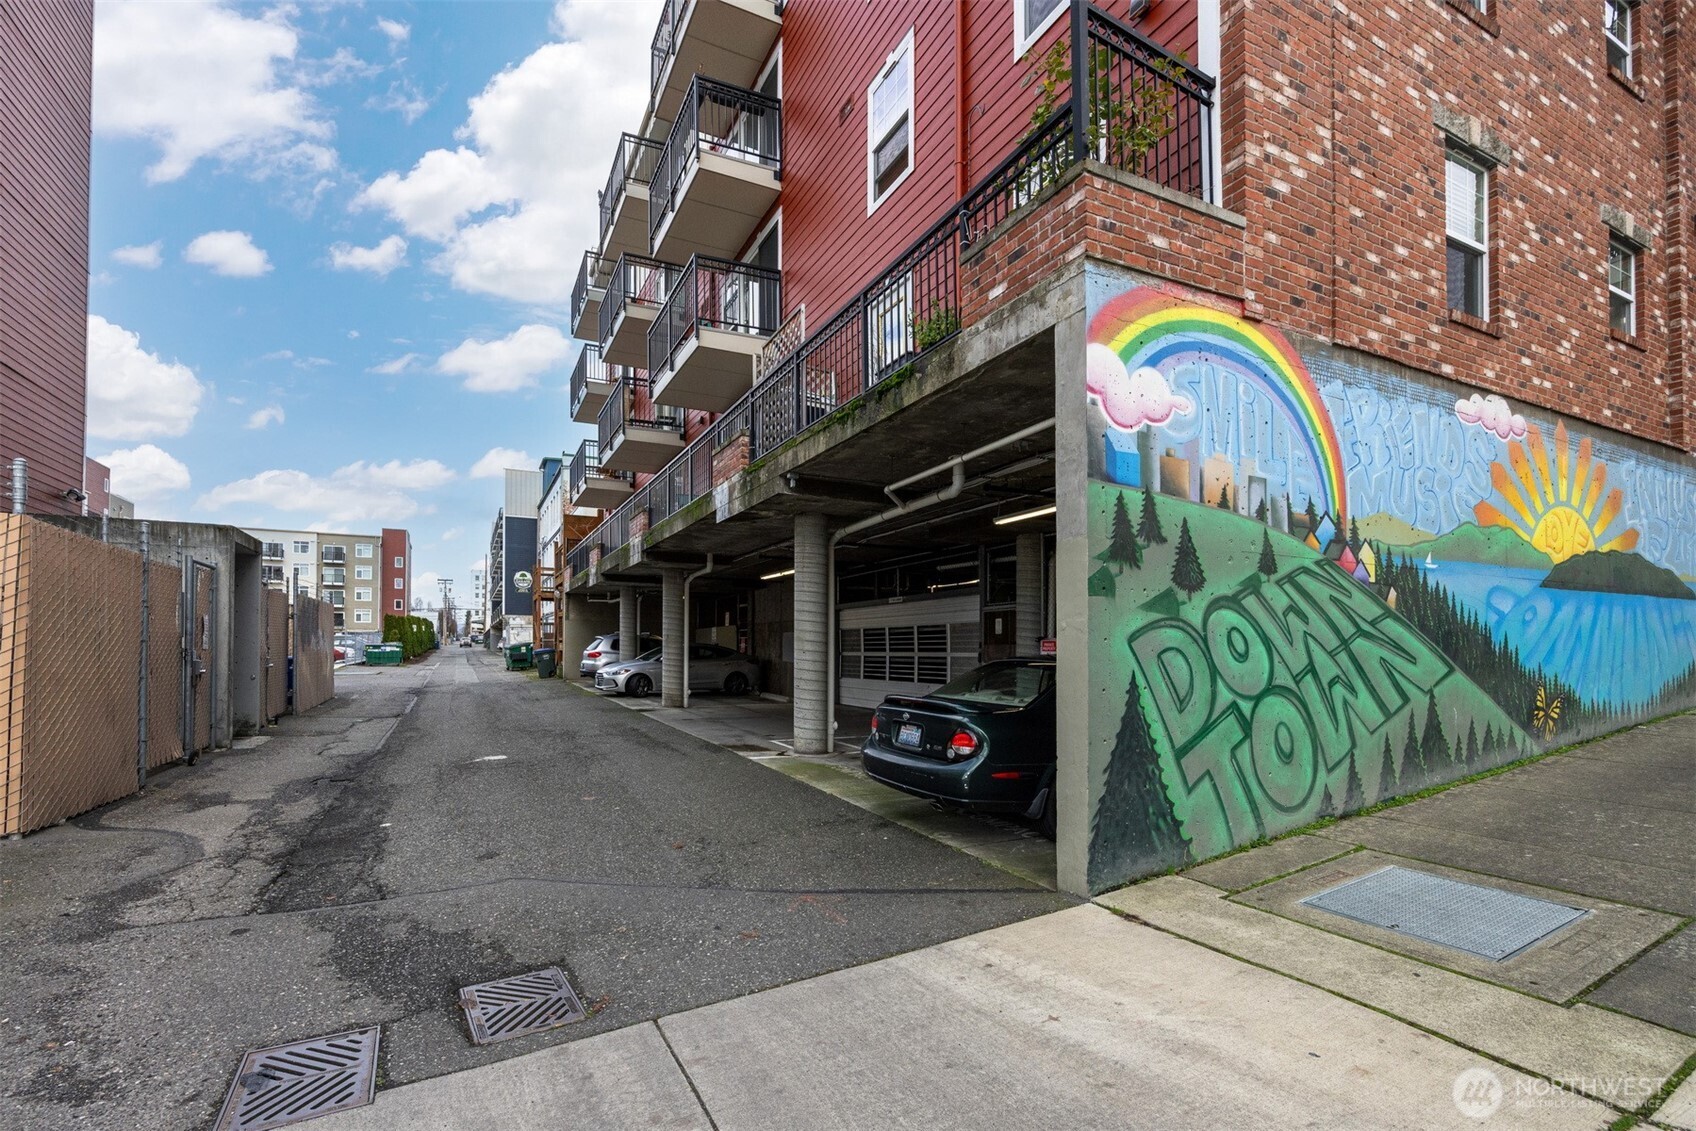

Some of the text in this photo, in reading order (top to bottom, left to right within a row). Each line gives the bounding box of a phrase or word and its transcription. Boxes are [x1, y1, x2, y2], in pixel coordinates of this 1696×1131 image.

[1347, 465, 1479, 535] MUSIC
[1544, 508, 1590, 559] LOVE
[1175, 611, 1456, 860] TOWN
